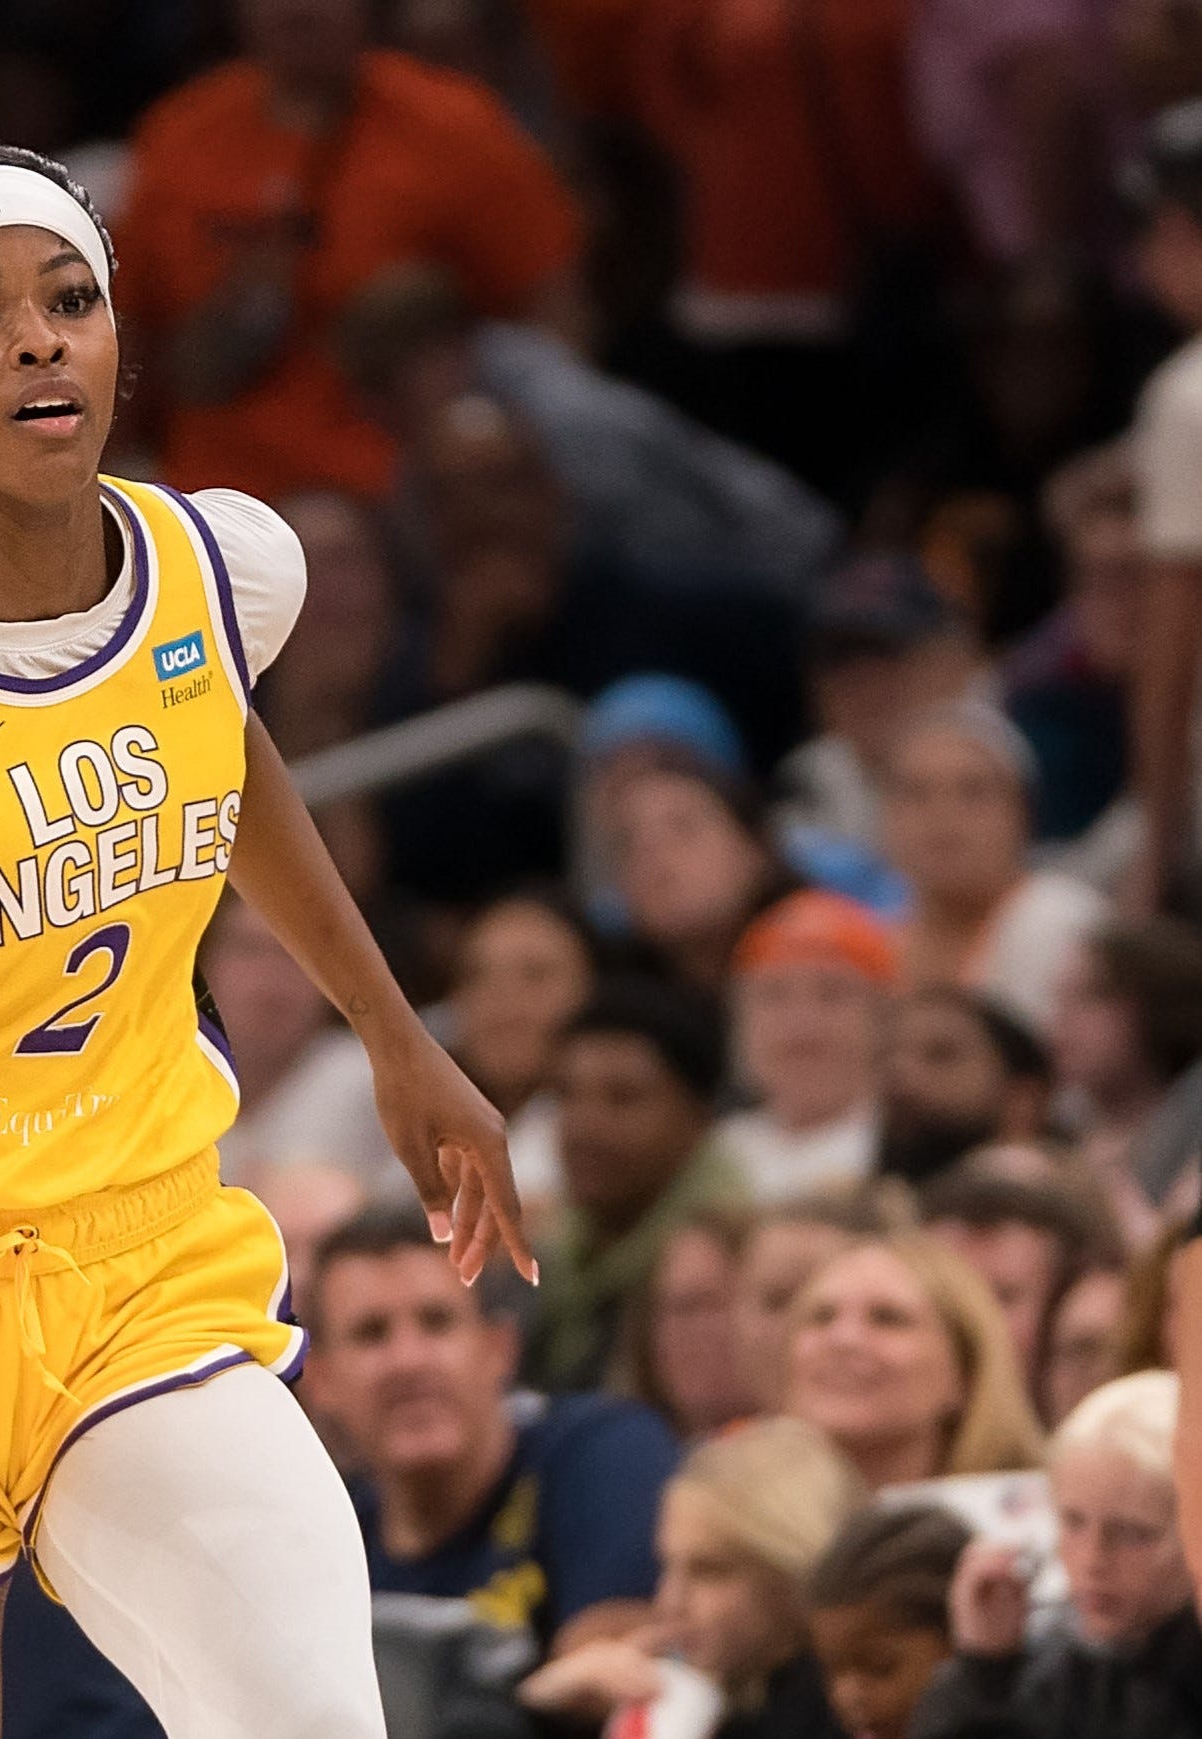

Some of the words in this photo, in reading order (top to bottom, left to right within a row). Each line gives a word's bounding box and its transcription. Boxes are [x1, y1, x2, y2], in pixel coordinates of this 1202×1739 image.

[160, 642, 201, 672] UCLA
[6, 724, 169, 850] LOS
[12, 921, 132, 1058] 2
